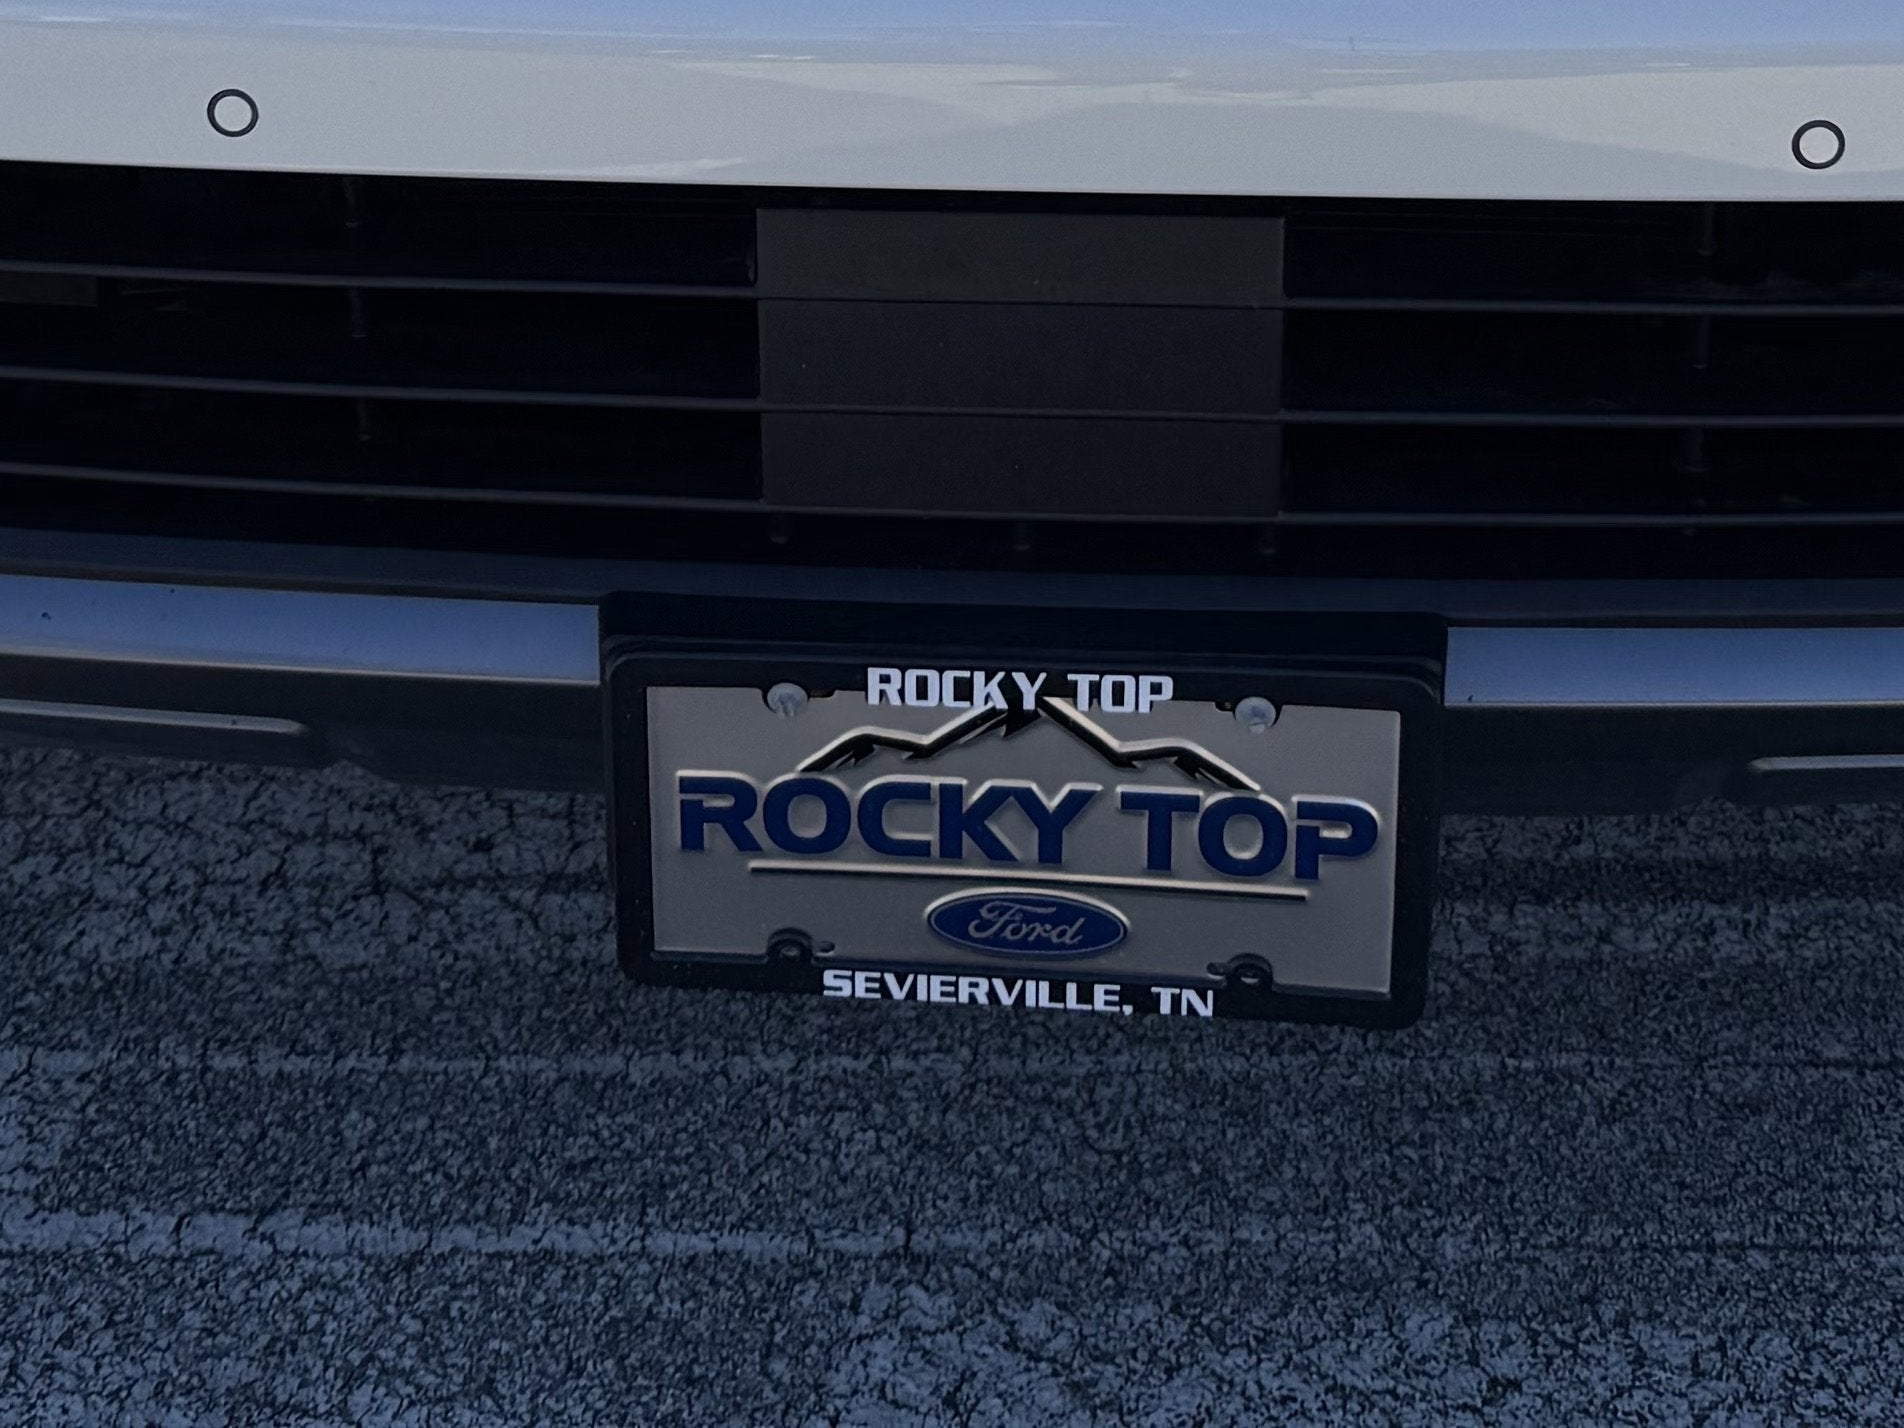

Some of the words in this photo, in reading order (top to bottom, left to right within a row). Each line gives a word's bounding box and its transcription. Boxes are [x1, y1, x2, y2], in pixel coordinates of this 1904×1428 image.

[867, 667, 1046, 710] ROCKY
[1067, 673, 1174, 714] TOP
[676, 772, 1103, 866] ROCKY
[1117, 789, 1381, 881] TOP
[968, 900, 1083, 946] Ford
[822, 969, 1135, 1015] SEVIERVILLE,
[1151, 985, 1214, 1018] TN
